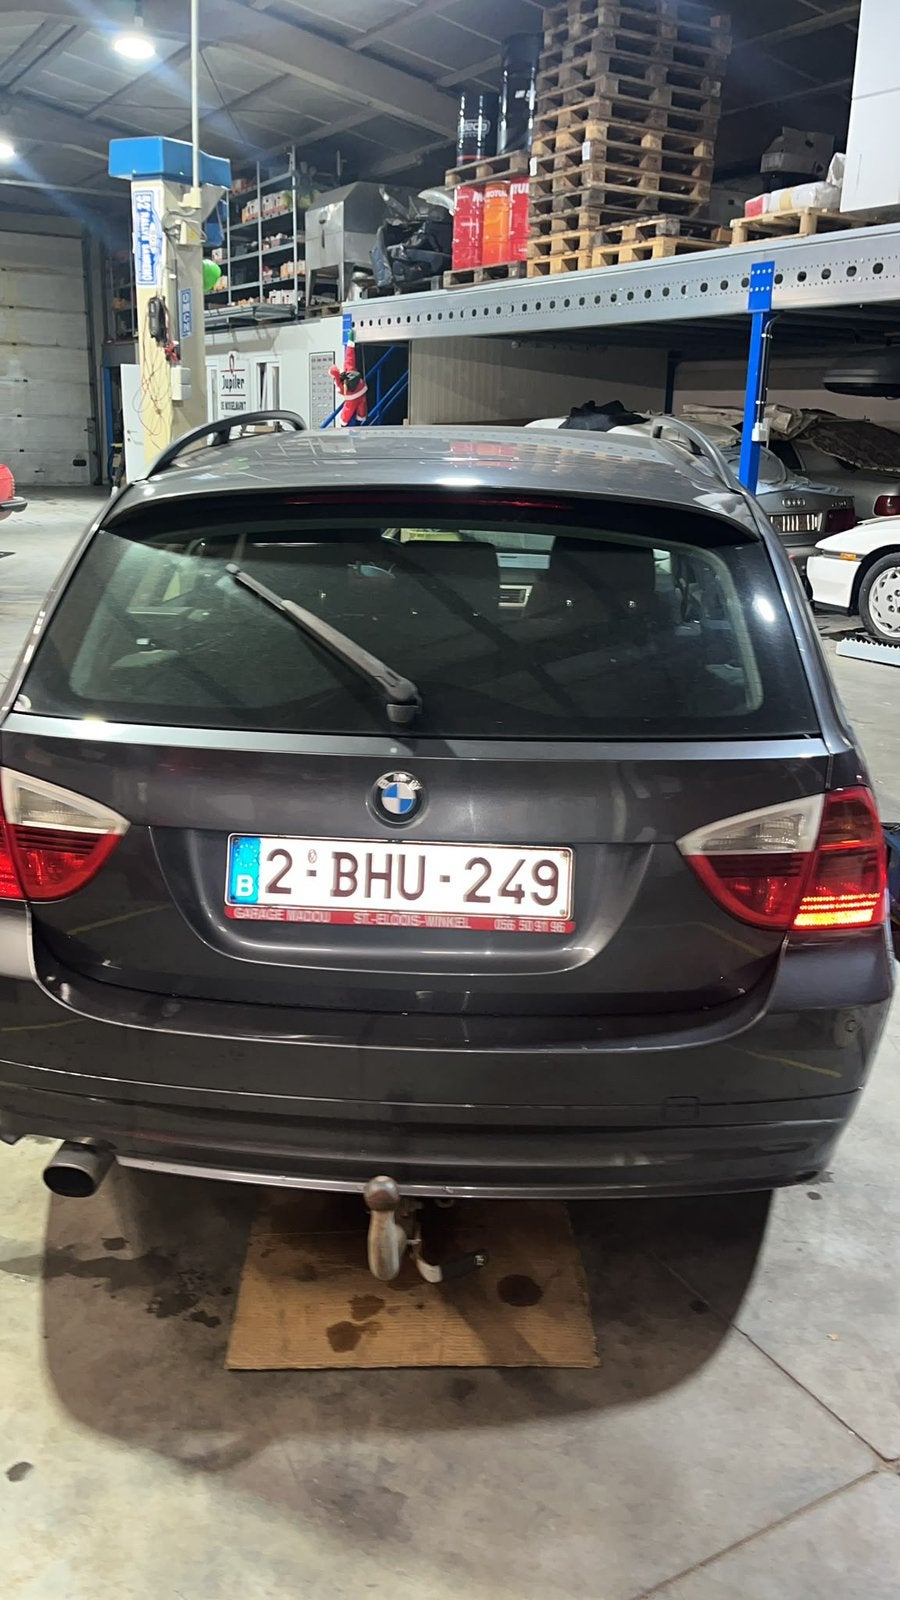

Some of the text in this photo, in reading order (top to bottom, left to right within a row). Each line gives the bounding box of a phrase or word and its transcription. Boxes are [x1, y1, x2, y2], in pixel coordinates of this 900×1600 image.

[221, 374, 245, 392] Jupiler
[236, 874, 254, 897] B
[233, 907, 285, 921] GARAGE
